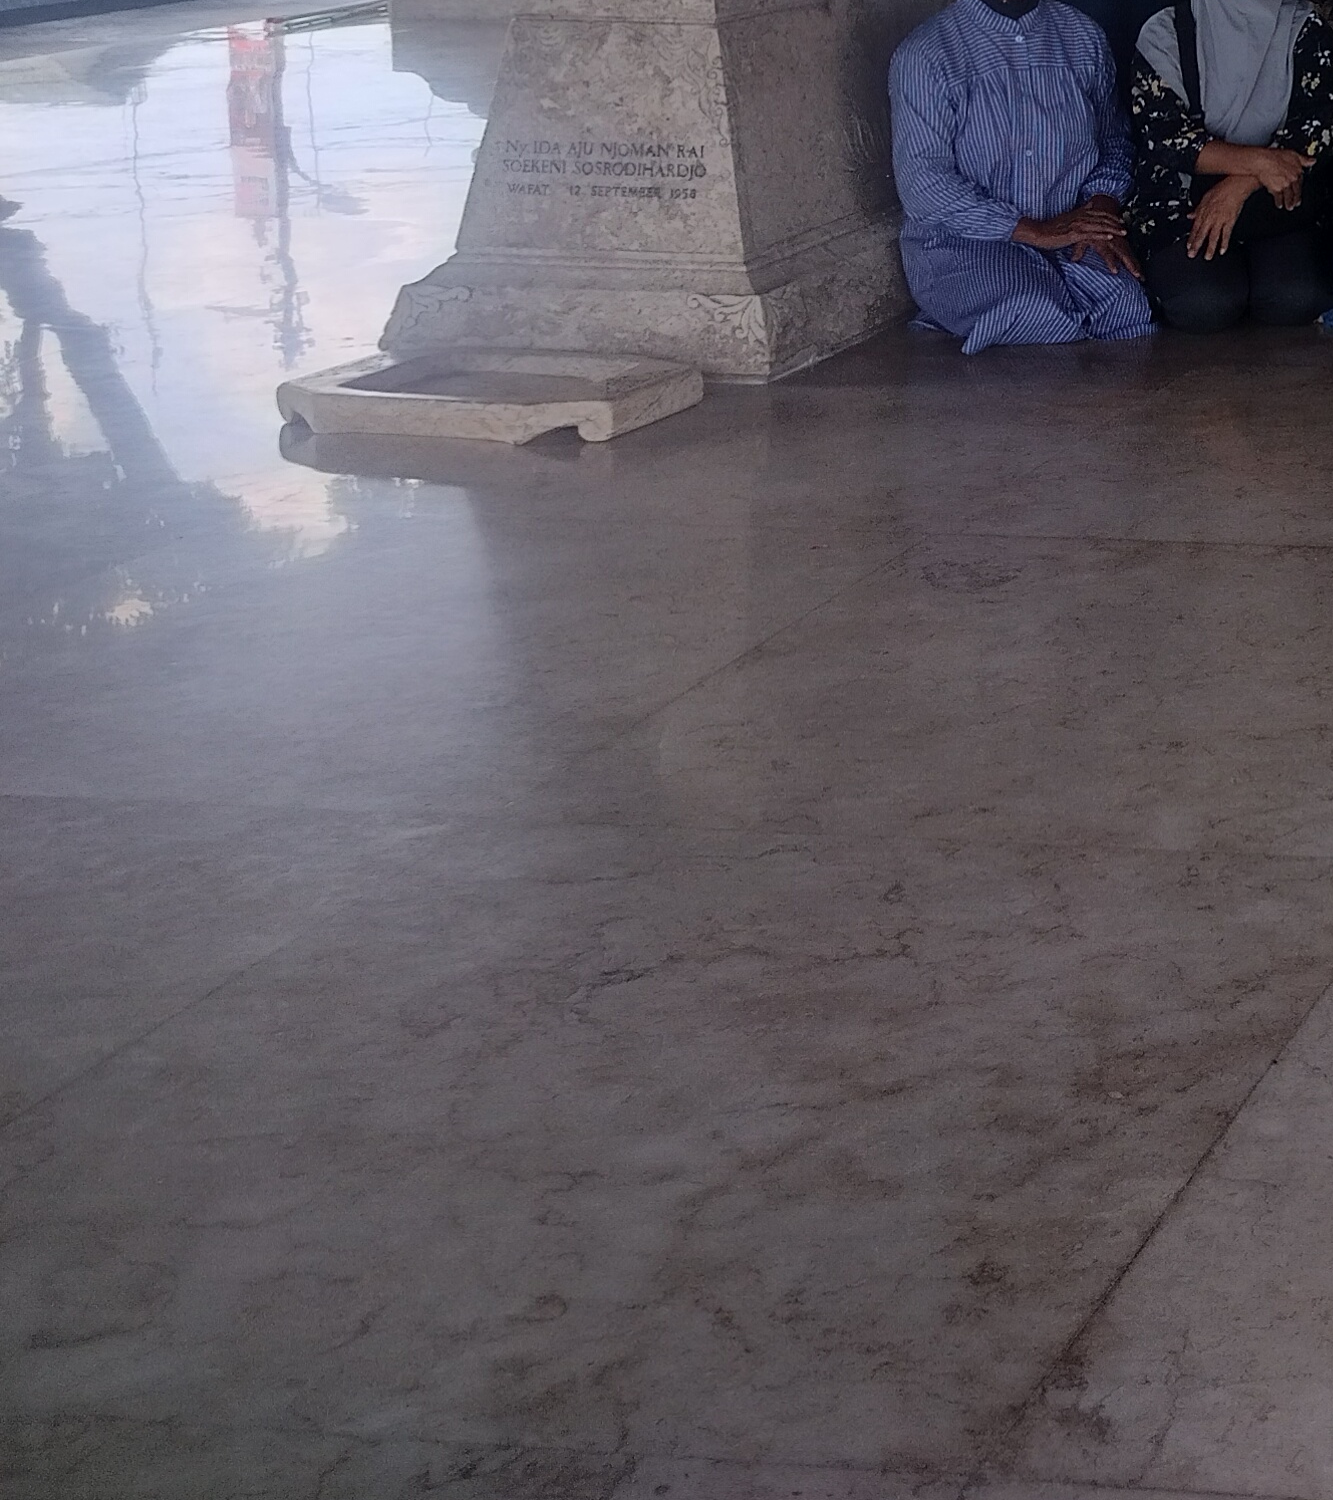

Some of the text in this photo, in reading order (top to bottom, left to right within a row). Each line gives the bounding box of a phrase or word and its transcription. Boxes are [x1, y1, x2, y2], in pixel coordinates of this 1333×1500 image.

[533, 141, 564, 155] IDA
[566, 142, 594, 158] AJU
[600, 143, 670, 160] NJOMAN
[676, 145, 705, 158] RAI
[503, 159, 706, 181] SOEKENI SOSRODIHARDJO
[507, 183, 550, 196] WAFAT
[568, 185, 581, 195] 12
[590, 185, 661, 198] SEPTEMBER
